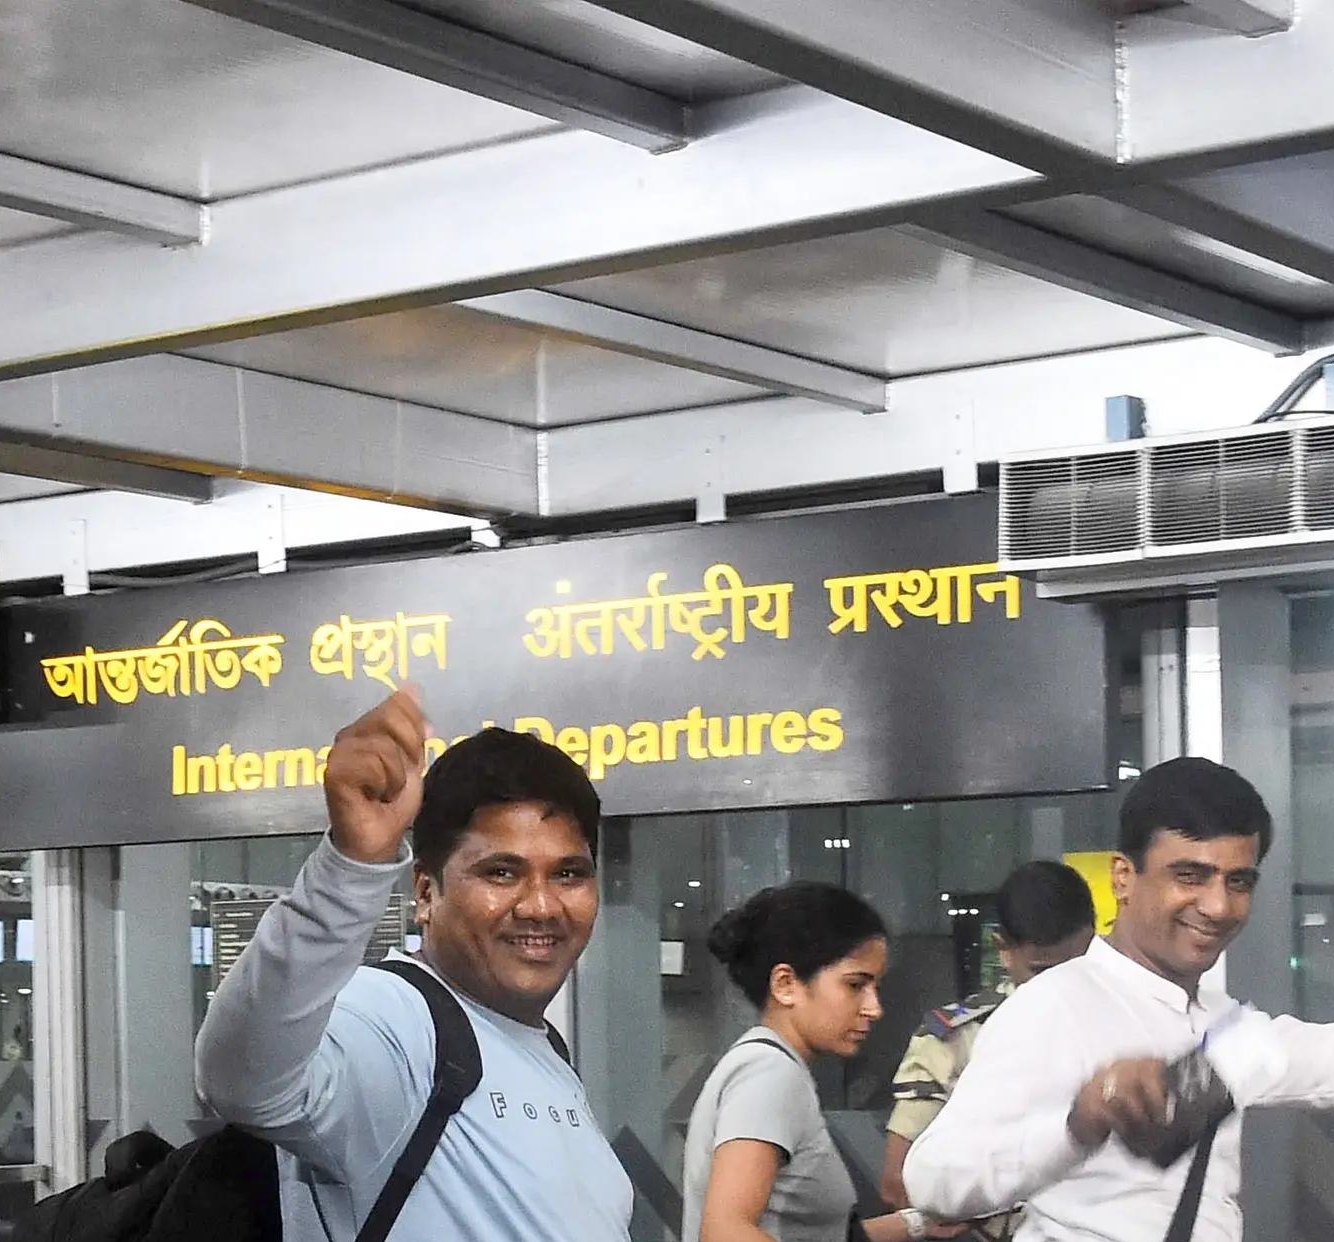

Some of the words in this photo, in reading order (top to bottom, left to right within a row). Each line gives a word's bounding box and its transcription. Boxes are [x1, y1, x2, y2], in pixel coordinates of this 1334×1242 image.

[41, 619, 285, 705] আন্তর্জাতিক
[310, 611, 452, 690] প্রস্থান
[522, 563, 793, 660] अंतर्राष्ट्रीय
[823, 562, 1020, 635] प्रस्थान
